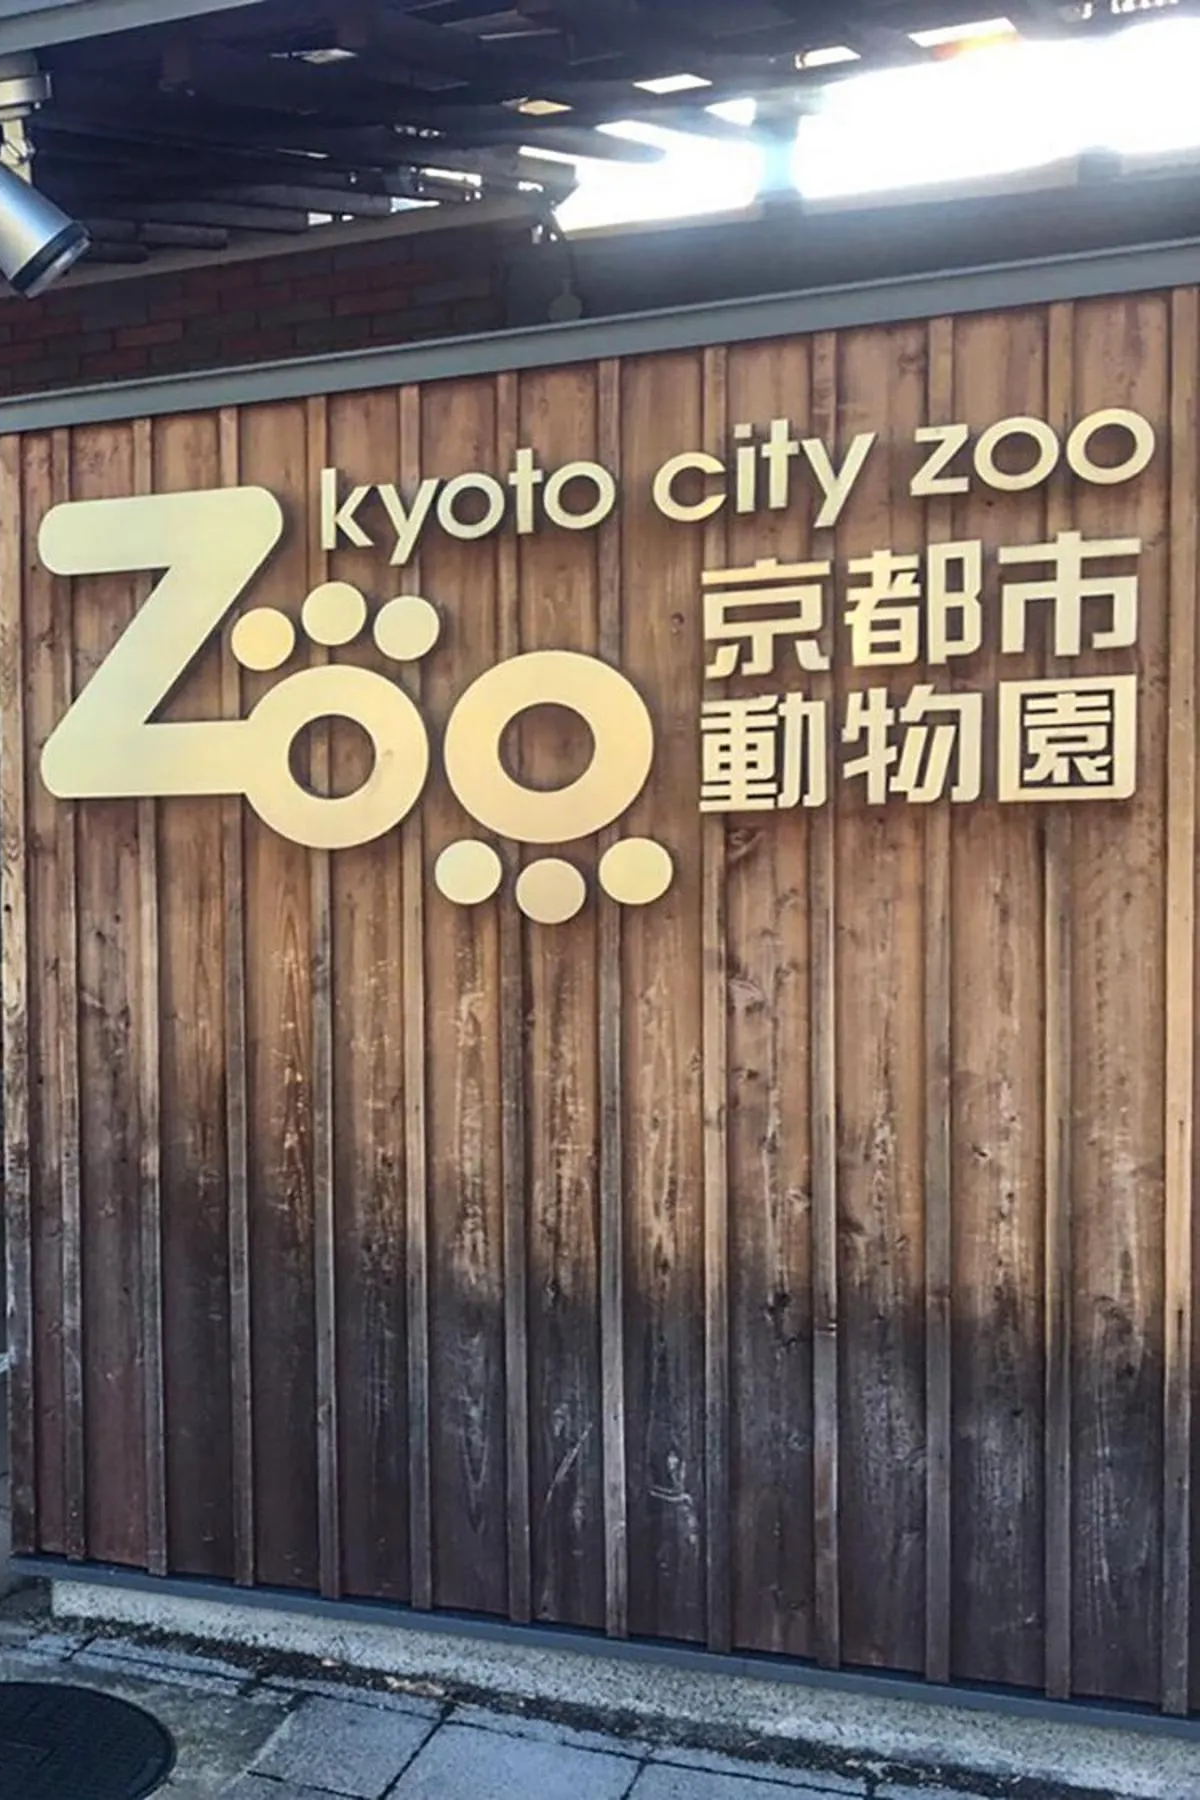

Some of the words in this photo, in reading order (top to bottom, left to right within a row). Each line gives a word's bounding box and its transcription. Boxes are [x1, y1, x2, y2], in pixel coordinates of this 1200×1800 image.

[321, 448, 615, 566] kyoto
[652, 419, 877, 528] city
[910, 408, 1155, 496] zoo
[701, 531, 1141, 679] 京都市
[699, 674, 1137, 812] 動物園
